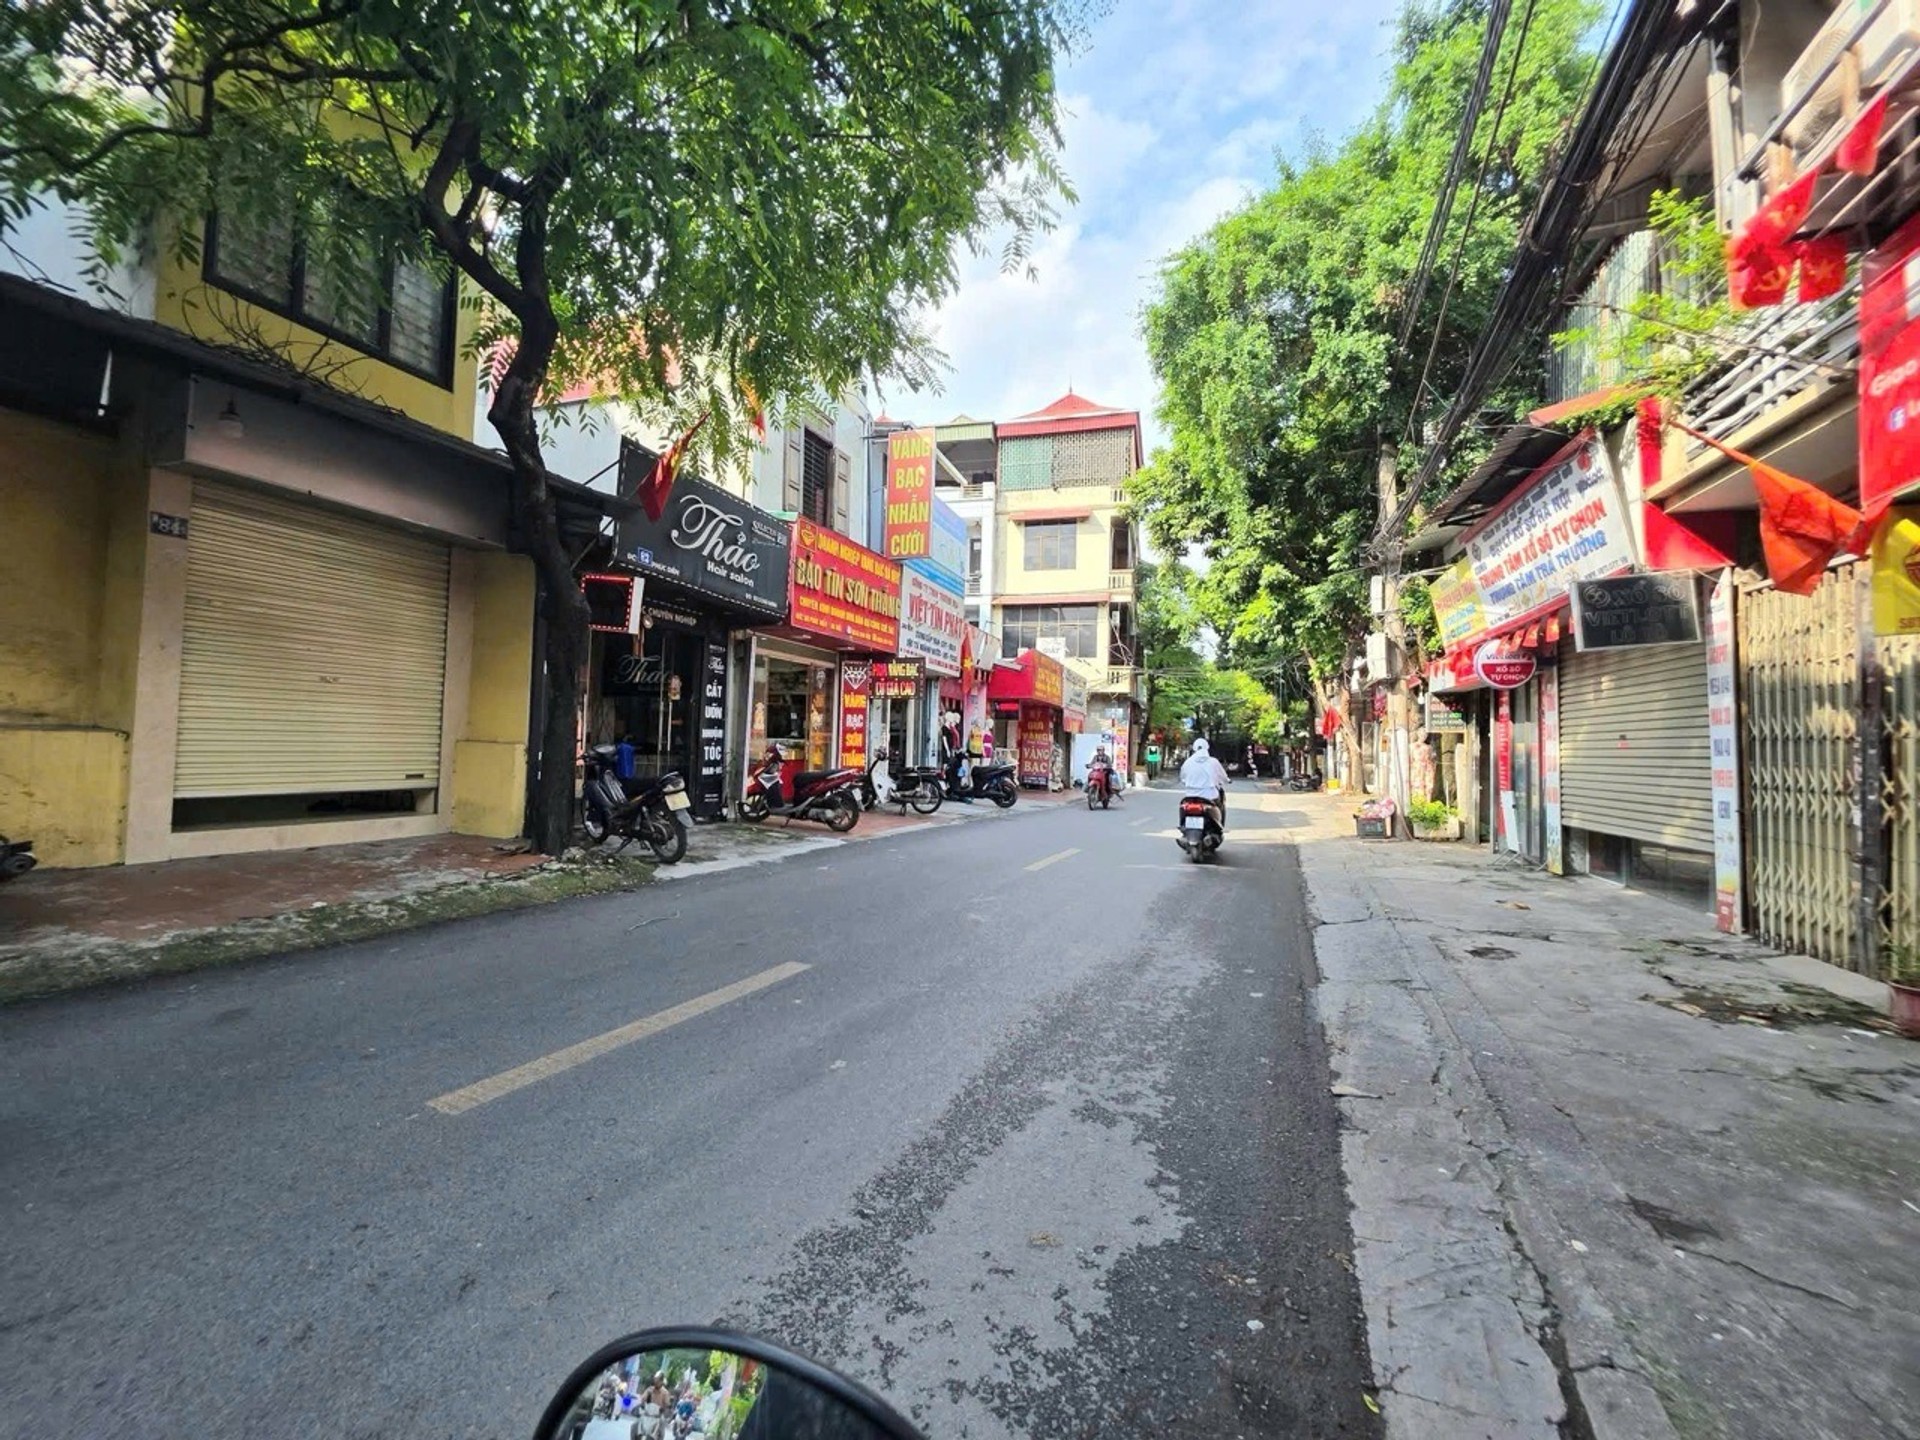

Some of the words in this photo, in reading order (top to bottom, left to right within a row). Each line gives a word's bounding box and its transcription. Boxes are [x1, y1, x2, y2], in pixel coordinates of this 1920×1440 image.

[892, 434, 930, 459] VÀNG
[896, 466, 925, 492] BẠC
[1569, 498, 1607, 535] CHỌN
[671, 494, 760, 573] Thảo
[891, 529, 925, 556] CƯỚI
[706, 560, 727, 578] Hair
[729, 570, 755, 588] salon
[706, 679, 722, 698] CẮT
[704, 742, 722, 760] TÓC
[1024, 761, 1048, 775] BẠC
